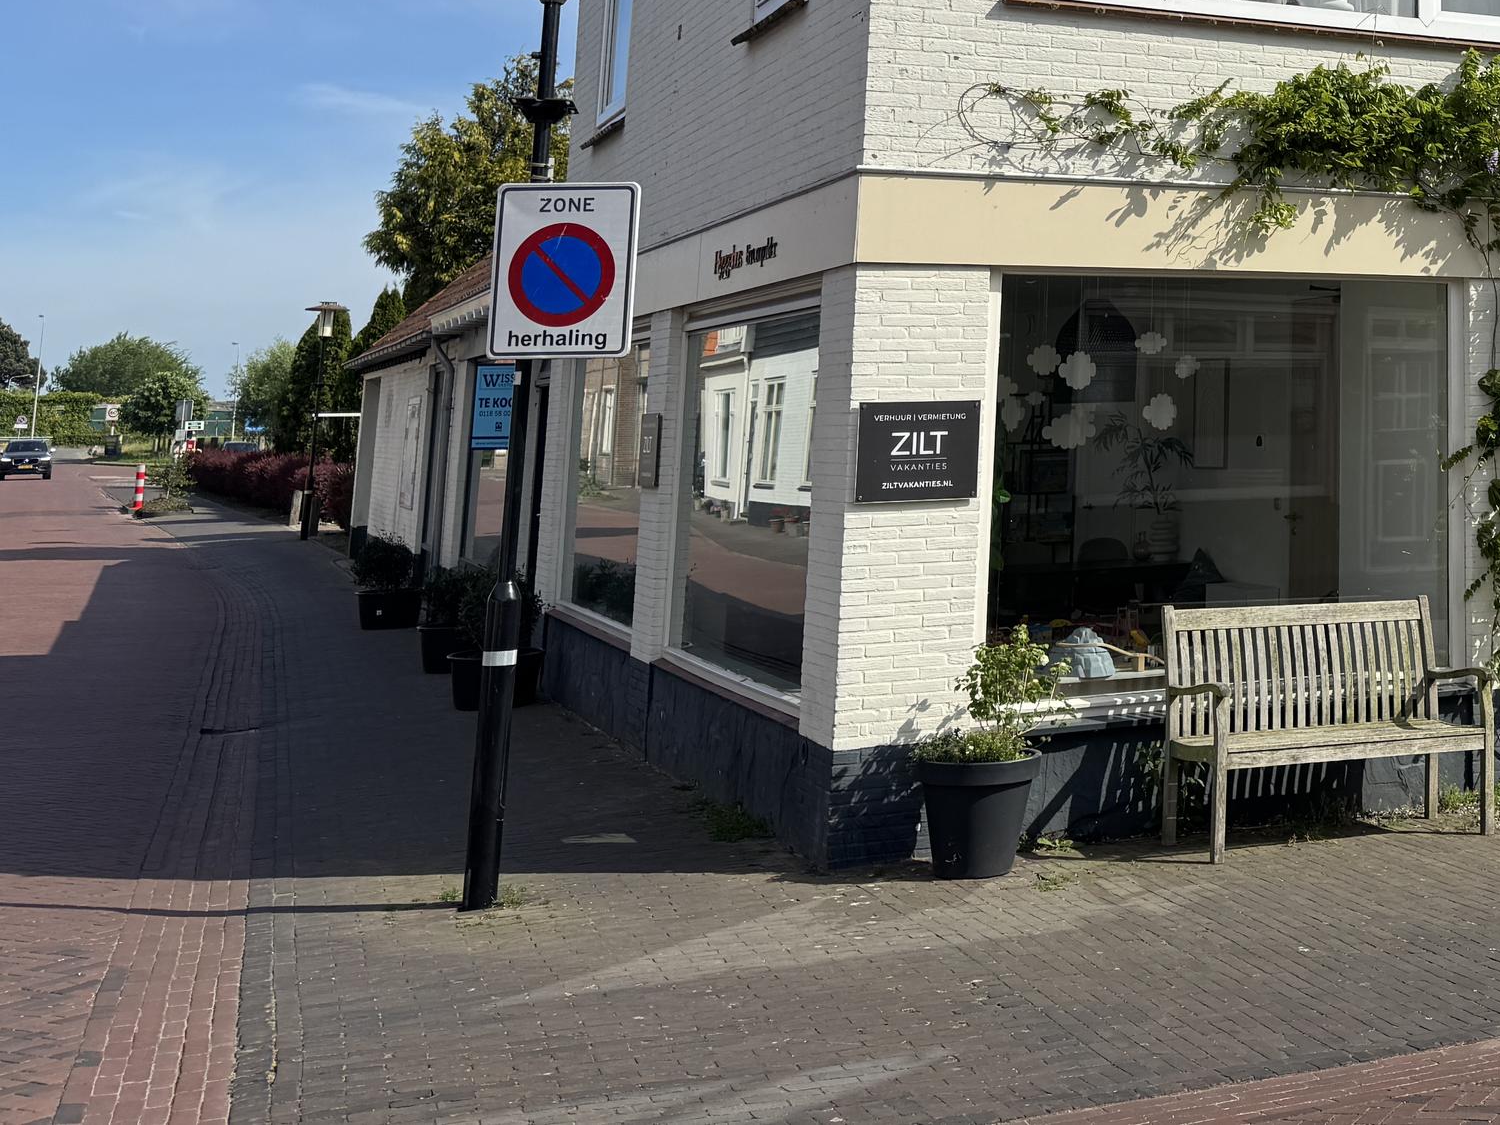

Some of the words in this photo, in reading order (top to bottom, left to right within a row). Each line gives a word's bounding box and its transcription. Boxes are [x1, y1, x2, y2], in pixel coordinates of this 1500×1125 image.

[538, 197, 595, 213] ZONE
[507, 330, 608, 350] herhaling
[482, 373, 515, 388] WISS
[478, 397, 491, 408] TE
[492, 397, 513, 408] KO
[874, 414, 912, 422] VERHUUR
[918, 413, 967, 421] VERMIETUNG
[890, 431, 949, 456] ZILT
[890, 462, 948, 472] VAKANTIES
[881, 479, 954, 490] ZILTVAKANTIES.NL
